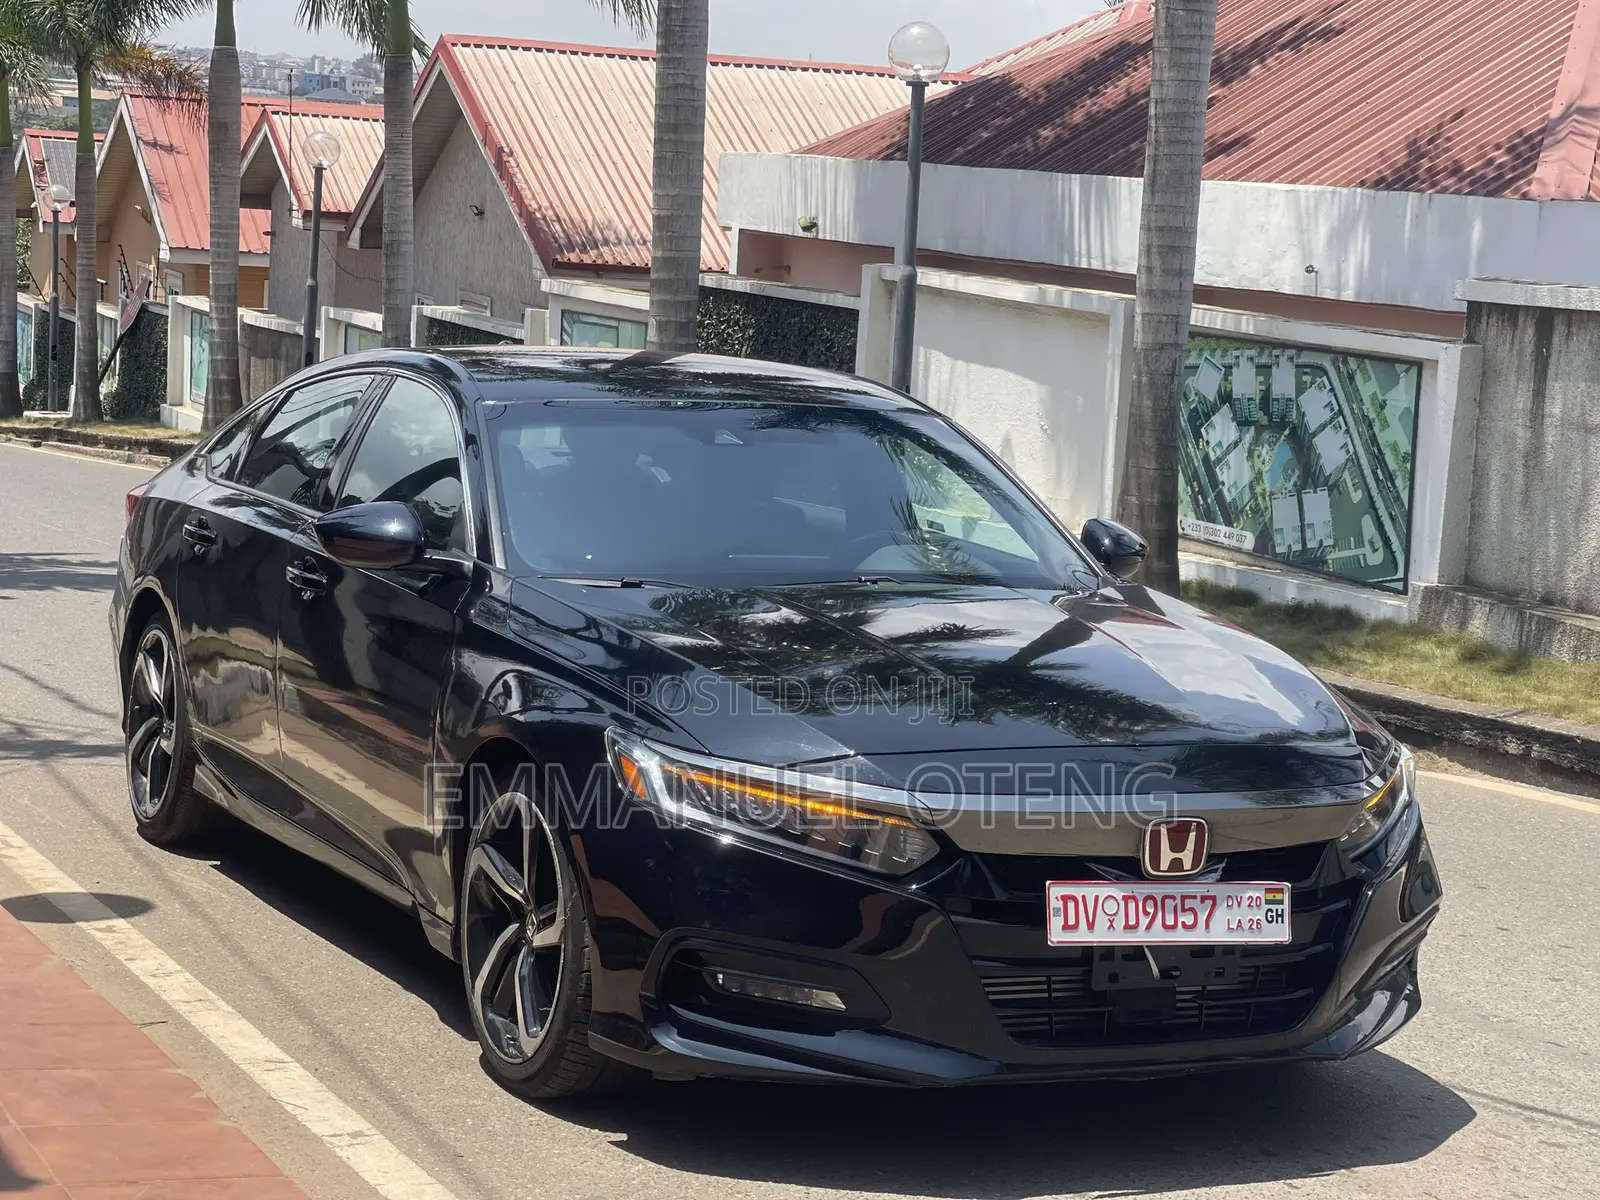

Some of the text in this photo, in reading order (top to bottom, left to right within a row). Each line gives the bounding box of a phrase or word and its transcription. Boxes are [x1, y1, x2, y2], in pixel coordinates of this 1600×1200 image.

[1188, 522, 1247, 543] +233 (0)302 449 037
[1226, 895, 1262, 908] DV 20
[1060, 894, 1099, 931] DV
[1265, 908, 1284, 924] GH
[1227, 917, 1262, 931] LA 26
